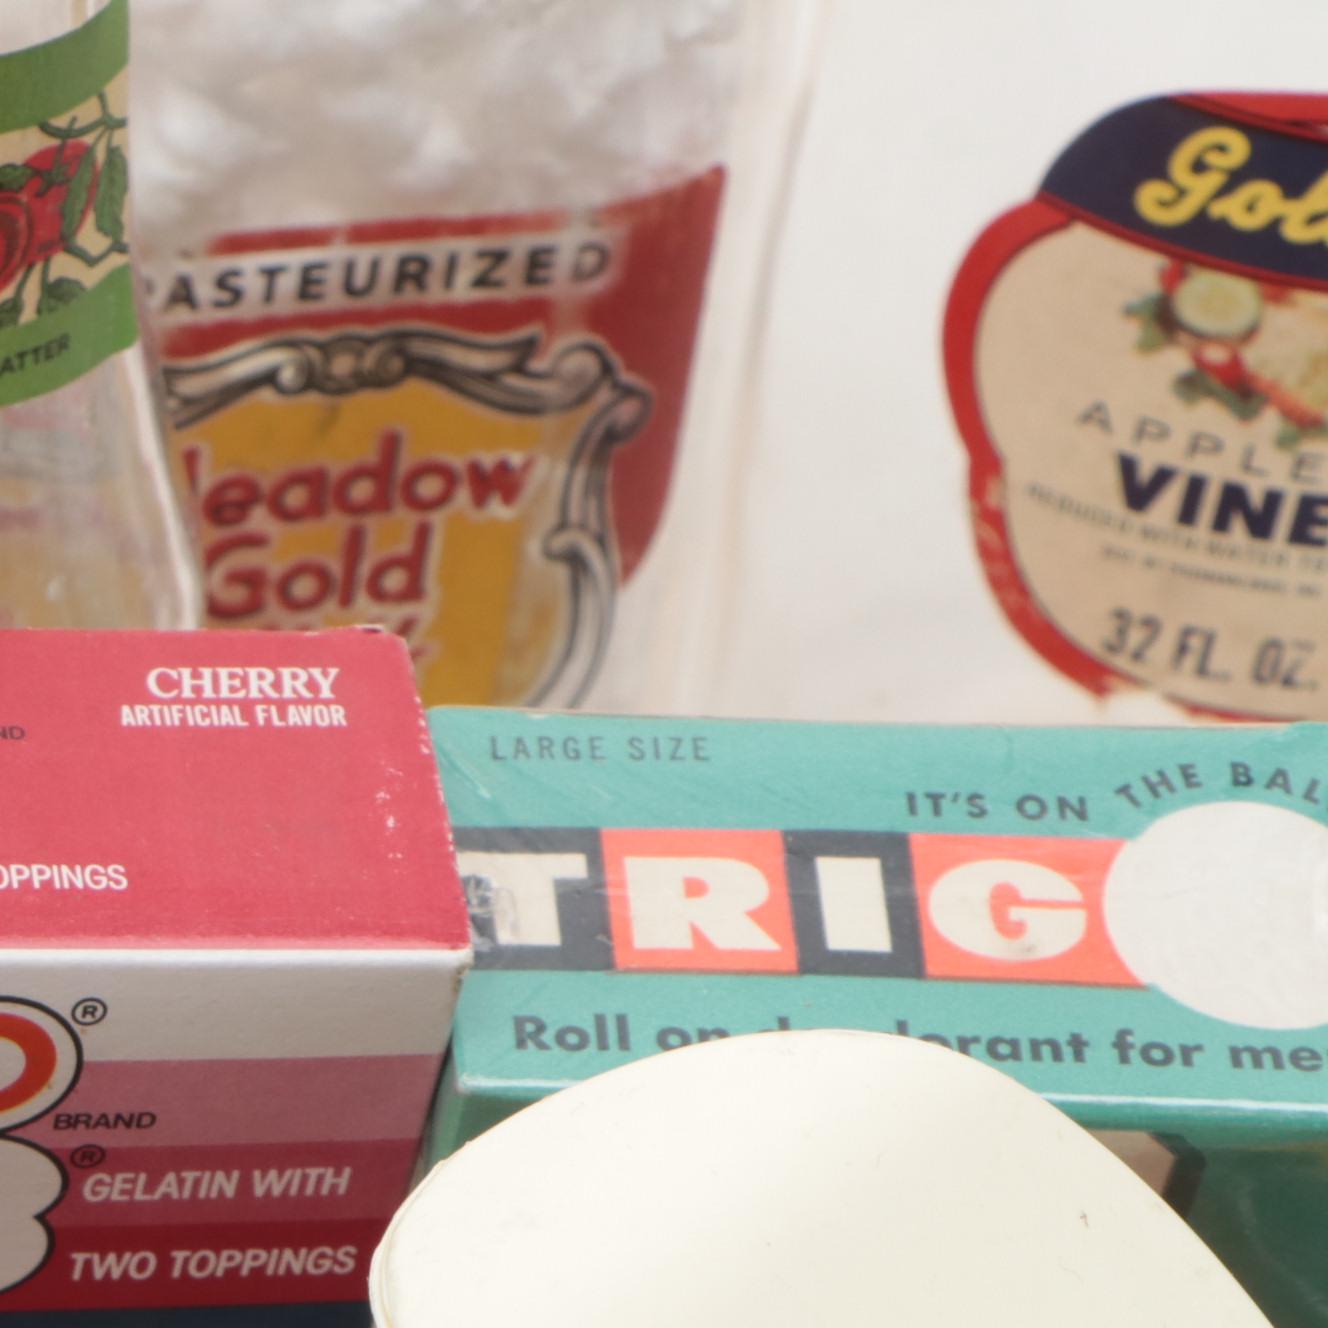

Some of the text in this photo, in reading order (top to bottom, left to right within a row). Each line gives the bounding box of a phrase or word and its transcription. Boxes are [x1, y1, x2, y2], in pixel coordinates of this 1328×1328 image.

[203, 517, 434, 620] Gold
[1170, 626, 1232, 686] FL.
[145, 667, 340, 699] CHERRY
[120, 704, 348, 727] ARTIFICIAL FLAVOR
[489, 735, 713, 762] LARGE SIZE
[905, 760, 1328, 822] IT'S ON THE BAL
[457, 851, 1088, 962] TRIG
[513, 1012, 631, 1051] Roll
[1112, 1028, 1204, 1068] for
[1229, 1041, 1328, 1073] me
[52, 1112, 157, 1131] BRAND
[82, 1166, 351, 1203] GELATIN WITH
[70, 1245, 358, 1282] TWO TOPPINGS
